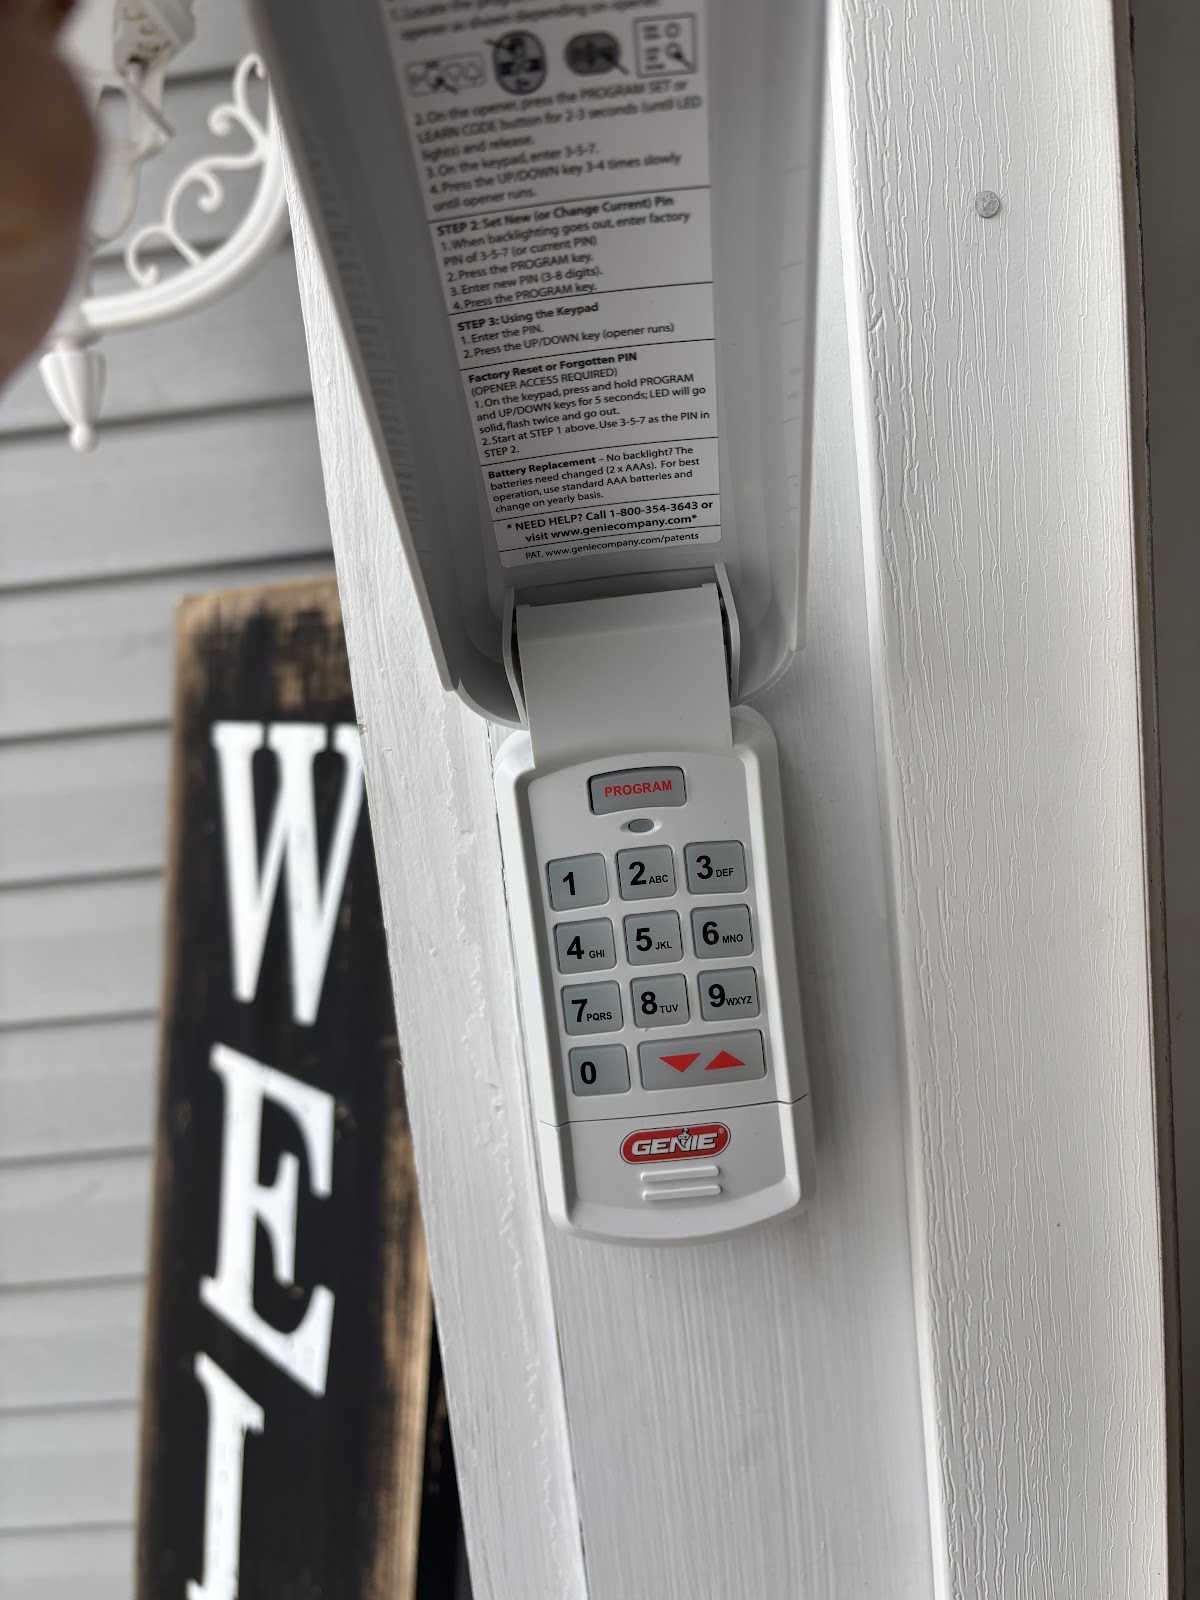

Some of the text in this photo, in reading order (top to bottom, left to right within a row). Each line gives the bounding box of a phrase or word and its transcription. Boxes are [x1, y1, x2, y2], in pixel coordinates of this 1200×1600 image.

[435, 221, 468, 237] STEP
[481, 215, 502, 229] Set
[503, 211, 531, 226] New
[532, 208, 551, 223] (or
[552, 202, 600, 221] Change
[601, 196, 652, 214] Current)
[654, 194, 674, 207] Pin
[440, 210, 691, 252] 1. When backlighting goes out, enter factory
[442, 234, 598, 268] PIN of 3-5-7 (or current PIN)
[445, 250, 594, 282] 2. Press the PROGRAM key.
[448, 265, 602, 297] 3. Enter new PIN (3-8 digits).
[451, 280, 597, 311] 4. Press the PROGRAM key.
[455, 301, 599, 332] STEP 3: Using the Keypad
[460, 323, 543, 345] 1. Enter the PIN.
[462, 322, 674, 358] 2. Press the UP/DOWN key (opener runs)
[467, 368, 511, 385] Factory
[510, 363, 543, 376] Reset
[558, 354, 615, 371] Forgotten
[617, 352, 637, 362] PIN
[470, 367, 618, 397] (OPENER ACCESS REQUIRED)
[474, 373, 694, 409] 1. On the keypad, press and hold PROGRAM
[475, 386, 706, 421] and UP/DOWN keys for 5 seconds; LED will go
[478, 406, 619, 435] solid, flash twice and go out.
[481, 436, 490, 446] 2.
[491, 432, 516, 444] Start
[516, 430, 528, 440] at
[529, 427, 554, 438] STEP
[556, 426, 561, 434] 1
[564, 421, 597, 433] above.
[598, 418, 619, 429] Use
[619, 416, 646, 426] 3-5-7
[660, 413, 678, 422] the
[680, 411, 697, 420] PIN
[699, 410, 709, 419] in
[483, 444, 519, 457] STEP 2.
[487, 446, 693, 480] Battery Replacement No backlight? The
[489, 477, 533, 490] batteries
[534, 473, 559, 483] need
[560, 467, 604, 481] changed
[605, 466, 615, 475] (2
[624, 461, 656, 473] AAAs).
[660, 460, 676, 468] For
[678, 458, 699, 466] best
[492, 487, 542, 503] operation,
[561, 479, 604, 491] standard
[605, 476, 627, 485] AAA
[629, 472, 671, 482] batteries
[673, 470, 692, 478] and
[494, 500, 530, 514] change
[546, 494, 576, 506] yearly
[577, 490, 603, 500] basis.
[514, 518, 546, 530] NEED
[548, 513, 583, 525] HELP?
[585, 510, 606, 520] Call
[609, 501, 697, 517] 1-800-354-3643
[524, 531, 549, 542] visit
[524, 532, 698, 559] PAT. www.geniecompany.com/patents
[604, 780, 672, 796] PROGRAM
[629, 862, 668, 885] 2 ABC
[696, 855, 733, 879] 3 DEF
[563, 872, 575, 895] 1
[567, 936, 604, 959] 4 GHI
[636, 928, 672, 951] 5 JKL
[703, 921, 743, 945] 6 MNO
[641, 991, 678, 1014] 8 TUV
[709, 984, 752, 1007] 9 WXYZ
[572, 999, 612, 1022] 7 PQRS
[581, 1061, 596, 1084] 0
[631, 1132, 718, 1156] GENIE
